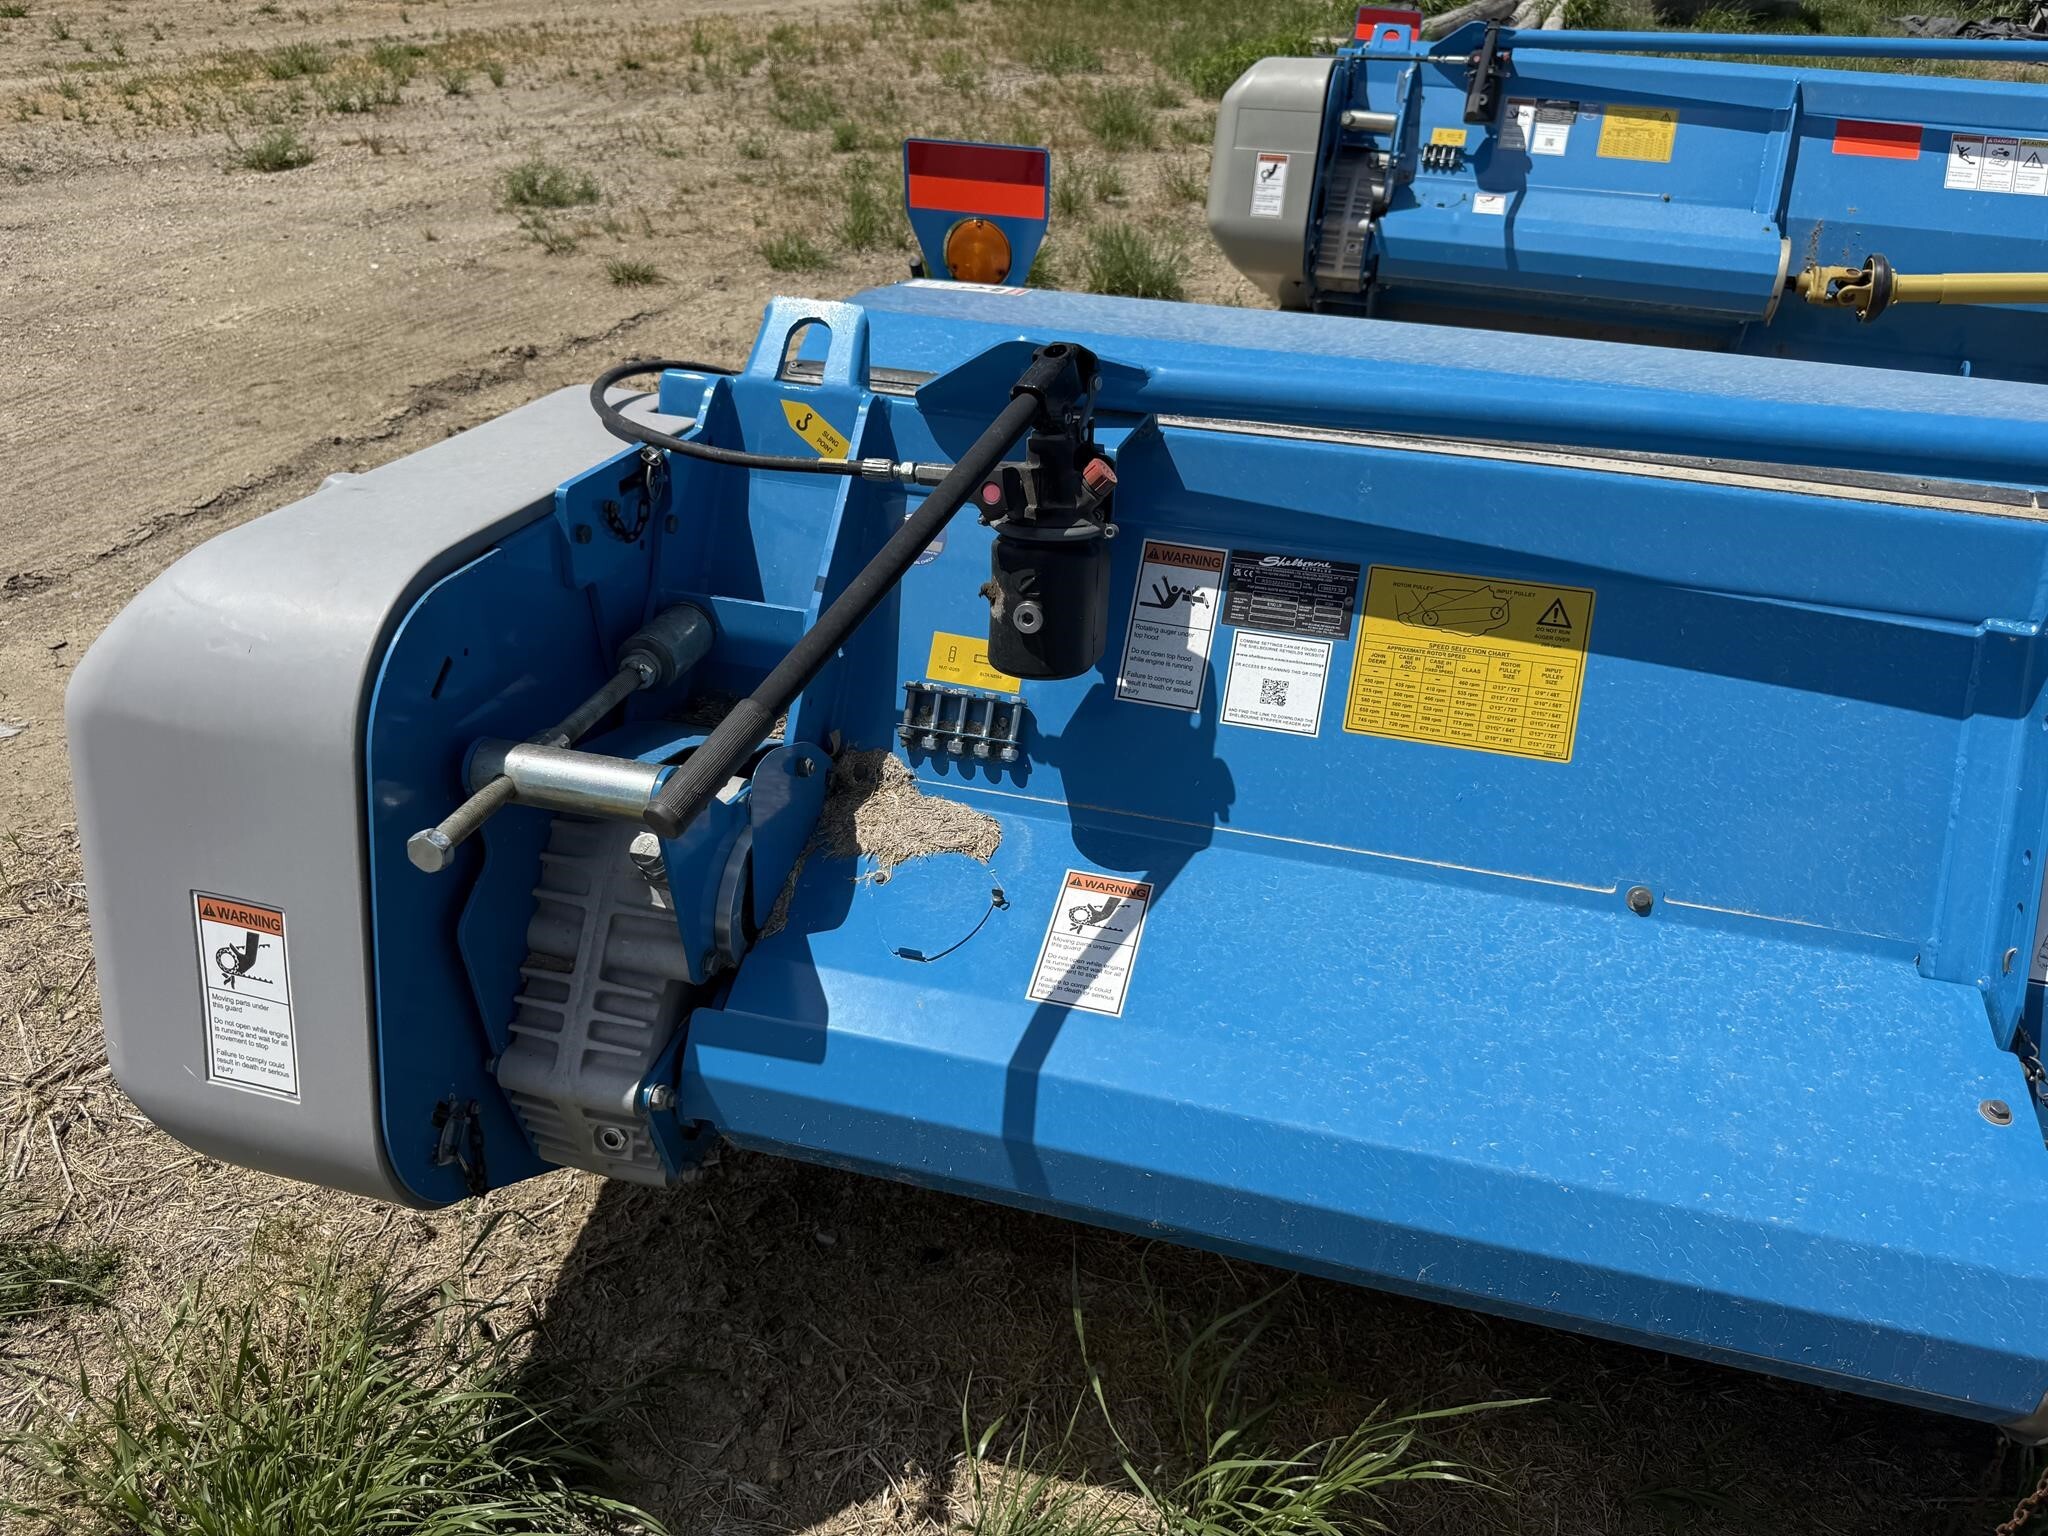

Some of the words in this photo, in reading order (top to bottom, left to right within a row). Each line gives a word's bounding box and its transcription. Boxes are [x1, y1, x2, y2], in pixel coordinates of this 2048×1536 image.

[816, 437, 833, 454] POINT
[821, 430, 839, 447] SLING
[1161, 551, 1221, 568] WARNING
[1258, 556, 1332, 568] Shelbourne
[1135, 624, 1159, 634] Rotating
[1387, 645, 1426, 654] APPROXIMATE
[1428, 643, 1450, 651] SPEED
[1451, 645, 1486, 655] SELECTION
[1488, 650, 1511, 658] CHART
[1130, 655, 1144, 663] while
[1145, 659, 1164, 667] engine
[1172, 663, 1193, 672] running
[1498, 667, 1521, 675] PULLEY
[1127, 671, 1146, 679] Failure
[1154, 676, 1175, 685] comply
[1124, 687, 1139, 696] injury
[1148, 682, 1165, 690] death
[1173, 687, 1193, 695] serious
[1085, 880, 1146, 897] WARNING
[218, 906, 280, 931] WARNING
[1053, 936, 1075, 945] Moving
[1052, 960, 1075, 969] running
[1069, 958, 1085, 966] open
[1086, 960, 1102, 968] while
[1103, 964, 1124, 973] engine
[1064, 987, 1084, 995] death
[1092, 992, 1114, 1001] serious
[1070, 982, 1093, 991] comply
[1095, 986, 1112, 994] could
[212, 993, 234, 1005] Moving
[236, 999, 250, 1008] parts
[252, 1002, 269, 1012] under
[225, 1004, 242, 1015] guard
[214, 1017, 223, 1025] Do
[236, 1023, 251, 1033] open
[253, 1026, 267, 1034] while
[269, 1030, 289, 1041] engine
[222, 1028, 244, 1039] running
[245, 1032, 257, 1040] and
[259, 1035, 270, 1043] wait
[215, 1034, 247, 1045] movement
[256, 1042, 269, 1052] stop
[217, 1049, 237, 1059] Failure
[246, 1055, 267, 1067] comply
[269, 1060, 284, 1069] could
[217, 1057, 233, 1065] result
[242, 1062, 259, 1072] death
[268, 1068, 289, 1078] serious
[218, 1065, 233, 1074] injury
